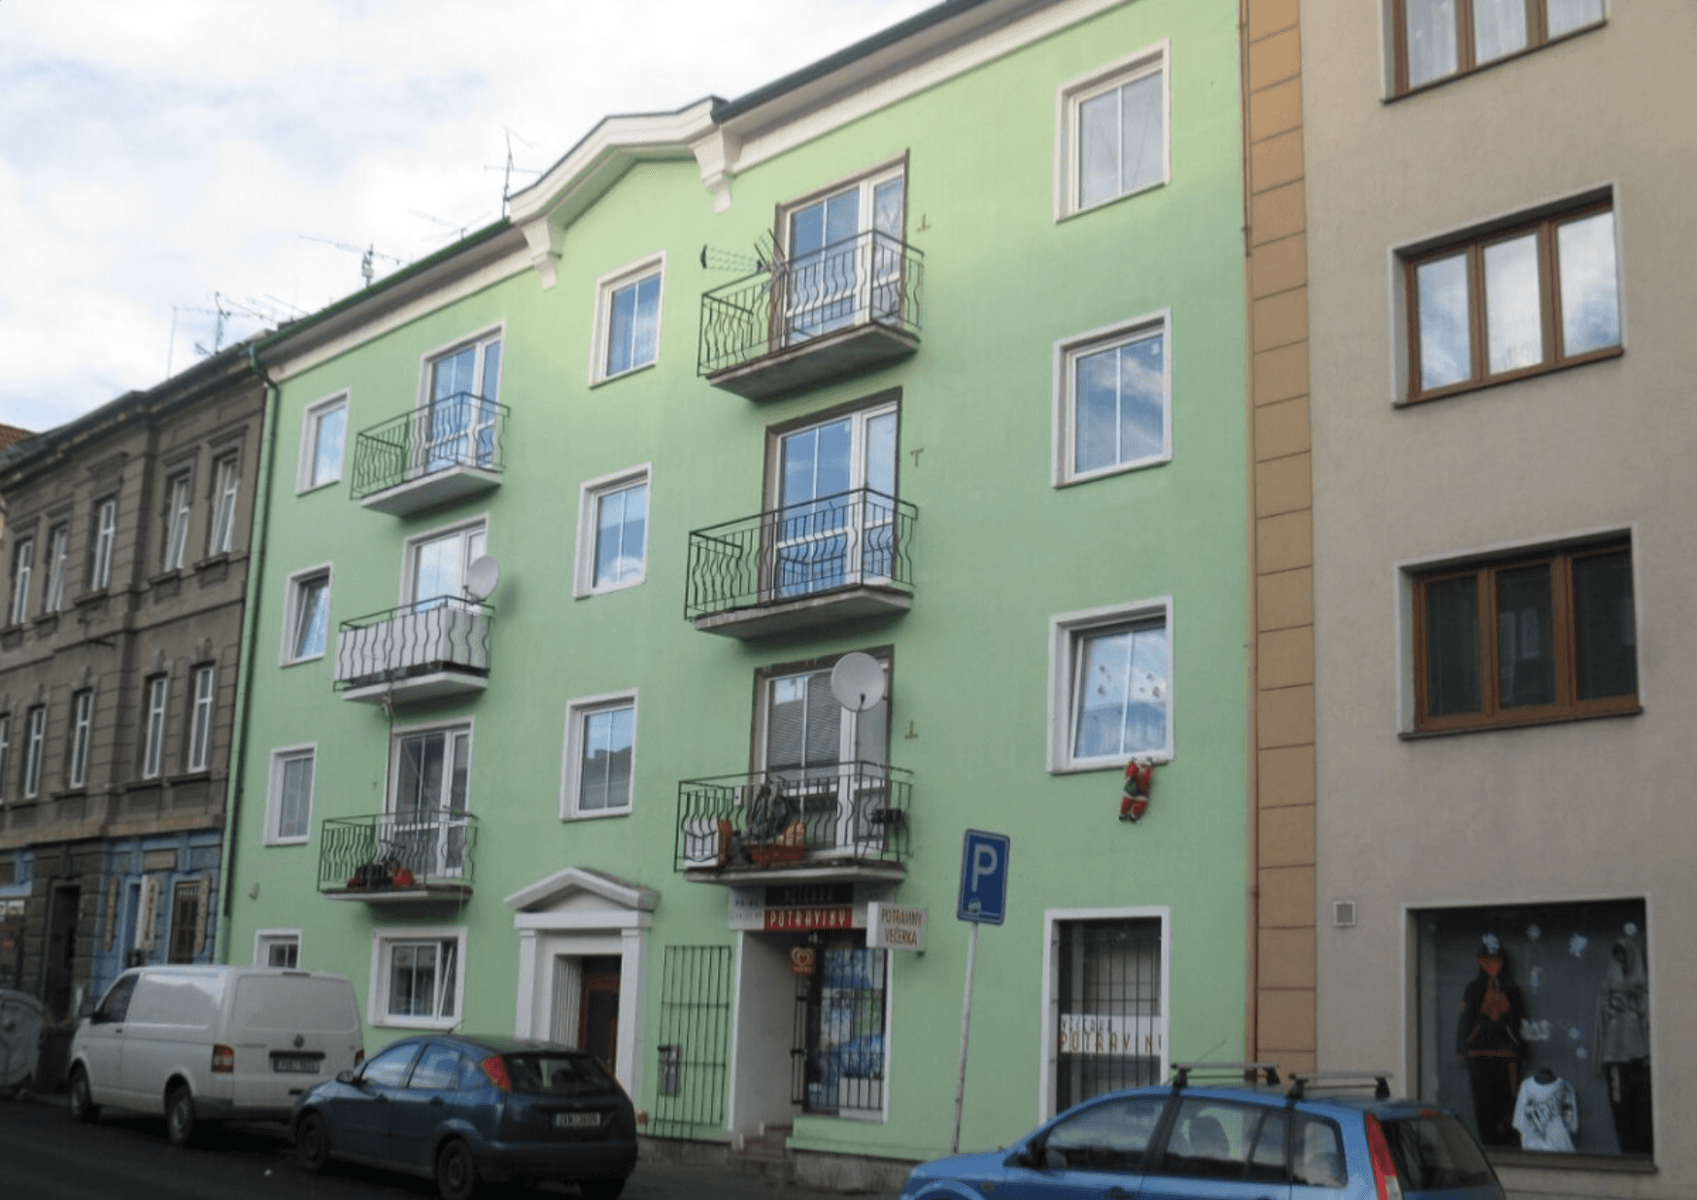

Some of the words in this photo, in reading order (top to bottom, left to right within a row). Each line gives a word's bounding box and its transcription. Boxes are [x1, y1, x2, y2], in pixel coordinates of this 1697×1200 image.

[971, 844, 998, 893] P
[770, 909, 846, 928] POTRAVINY
[881, 907, 922, 928] POTRAVINY
[885, 926, 918, 946] VEČERKA
[1060, 1030, 1161, 1053] POTRAVN
